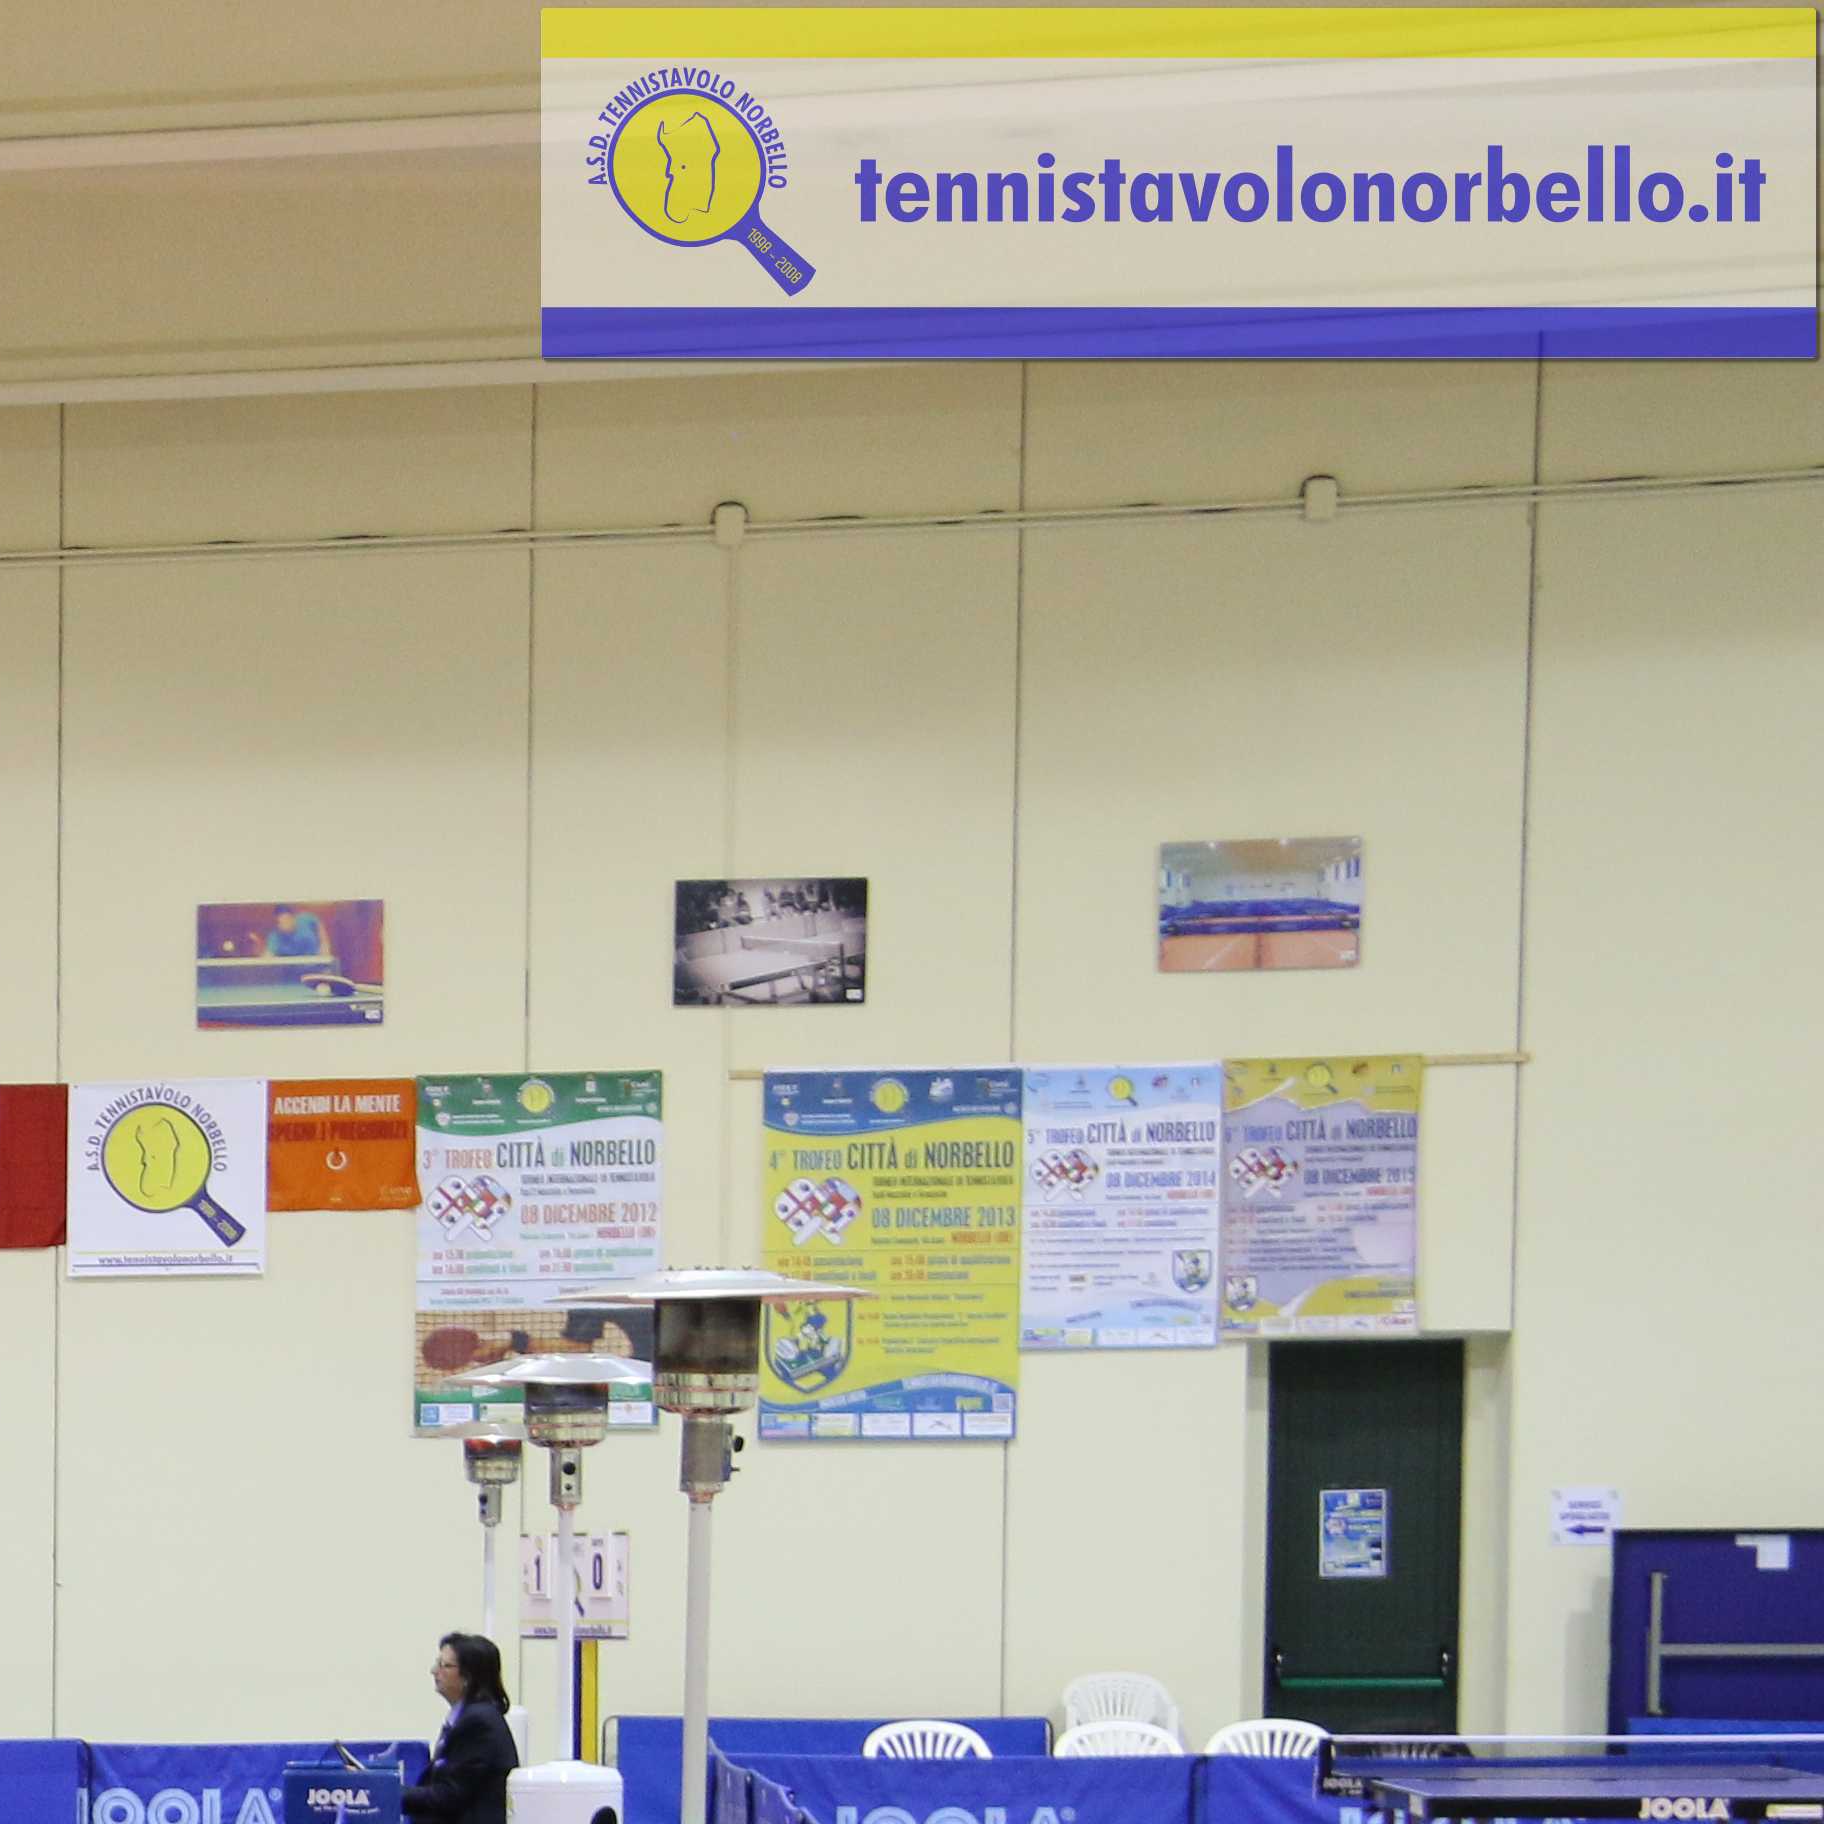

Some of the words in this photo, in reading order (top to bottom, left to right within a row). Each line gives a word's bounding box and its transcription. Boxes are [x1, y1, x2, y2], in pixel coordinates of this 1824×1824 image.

[274, 1096, 330, 1114] ACCENDI
[334, 1095, 352, 1112] LA
[355, 1094, 400, 1112] MENTE
[95, 1085, 191, 1128] TENNISTAVOLO
[191, 1104, 227, 1171] NORBELLO
[1087, 1118, 1126, 1143] CITTÀ
[1146, 1121, 1215, 1142] NORBELLO
[1346, 1117, 1417, 1139] NORBELLO
[445, 1149, 492, 1169] TROFEO
[497, 1137, 544, 1168] CITTÀ
[570, 1139, 655, 1166] NORBELLO
[793, 1150, 842, 1170] TROFEO
[848, 1138, 897, 1169] CITTÀ
[924, 1141, 1013, 1167] NORBELLO
[1125, 1172, 1182, 1187] DICEMBRE
[1187, 1171, 1216, 1186] 2014
[521, 1205, 537, 1225] 08
[544, 1203, 615, 1224] DICEMBRE
[622, 1202, 656, 1222] 2012
[872, 1208, 890, 1228] 08
[896, 1207, 971, 1227] DICEMBRE
[979, 1206, 1015, 1226] 2013
[535, 1555, 540, 1591] 1
[593, 1553, 602, 1590] 0
[307, 1789, 370, 1806] JOOLA
[1639, 1797, 1729, 1819] JOOLA
